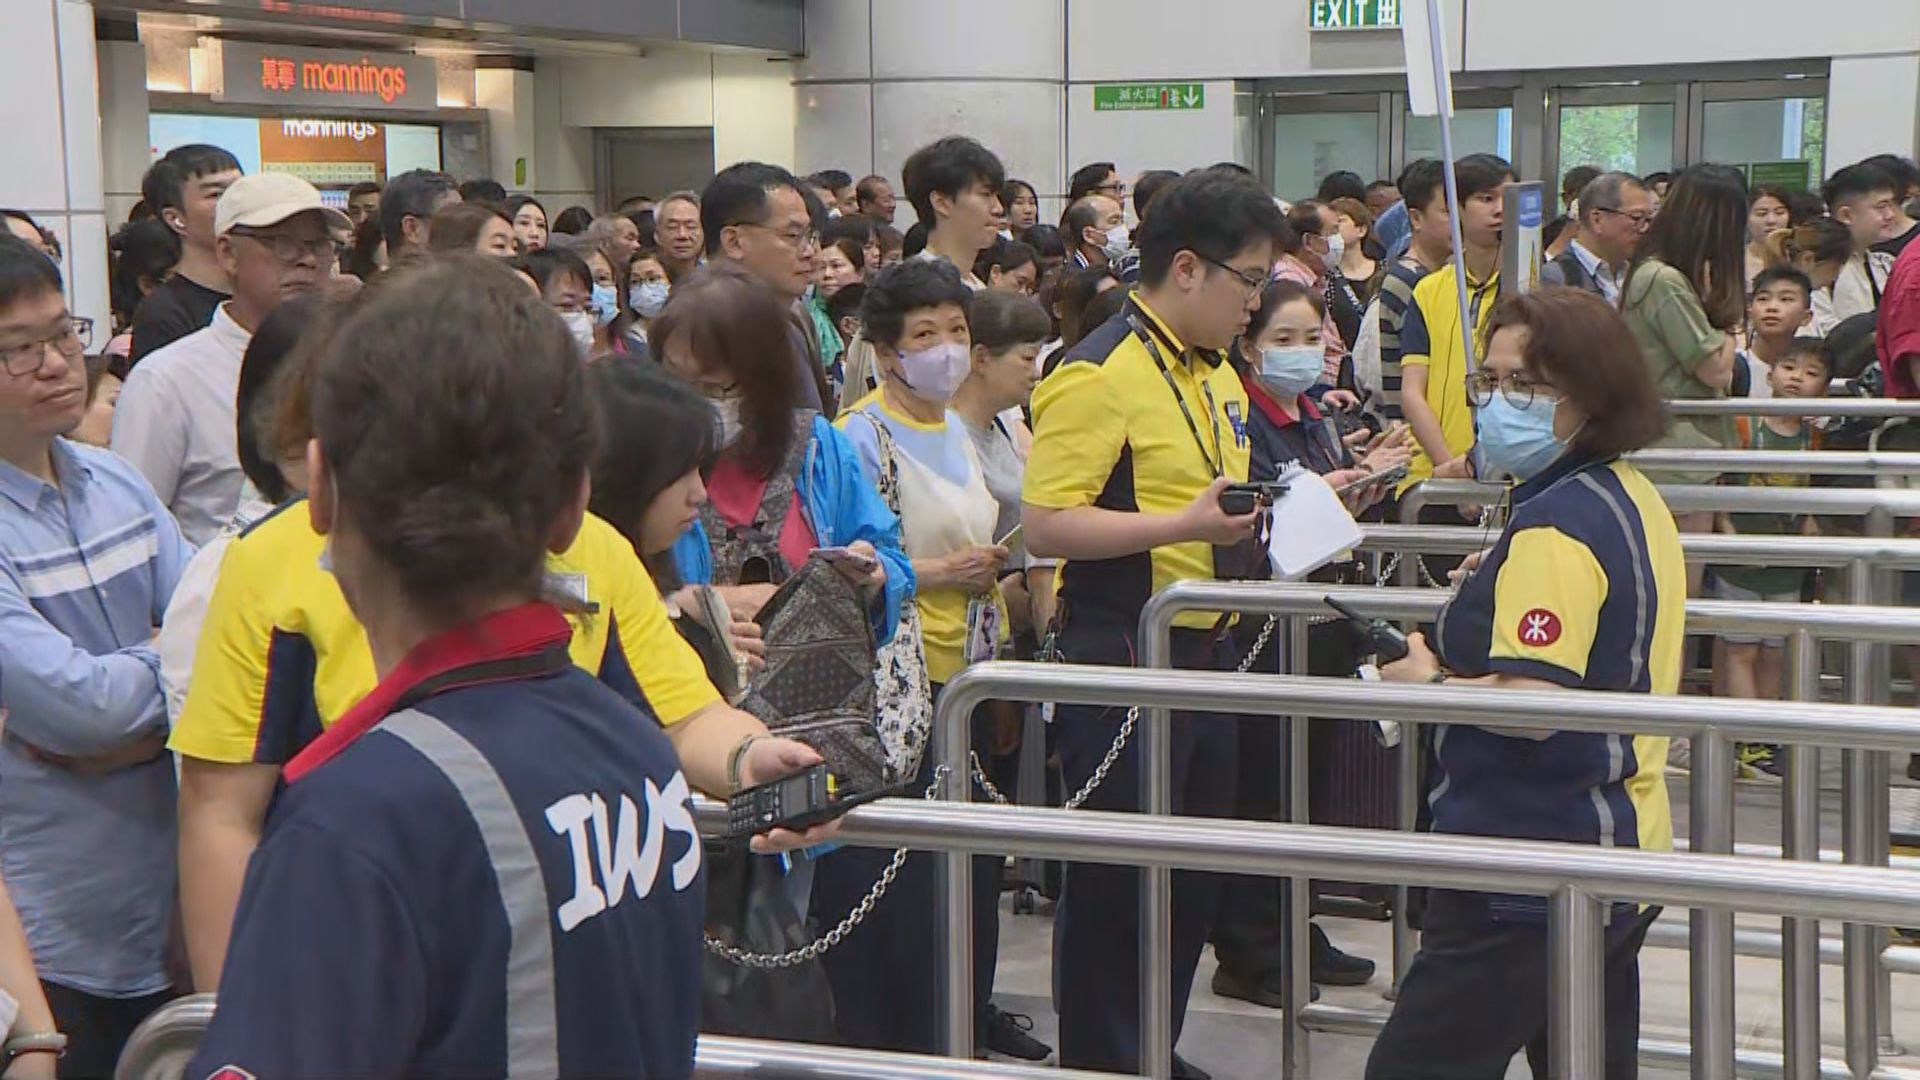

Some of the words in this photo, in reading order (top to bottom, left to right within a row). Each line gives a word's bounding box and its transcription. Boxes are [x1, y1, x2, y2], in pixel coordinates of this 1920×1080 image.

[1313, 0, 1368, 27] EXIT
[261, 58, 296, 91] 萬寧
[303, 57, 407, 103] mannings
[284, 119, 377, 141] mannings
[544, 769, 702, 932] IWS
